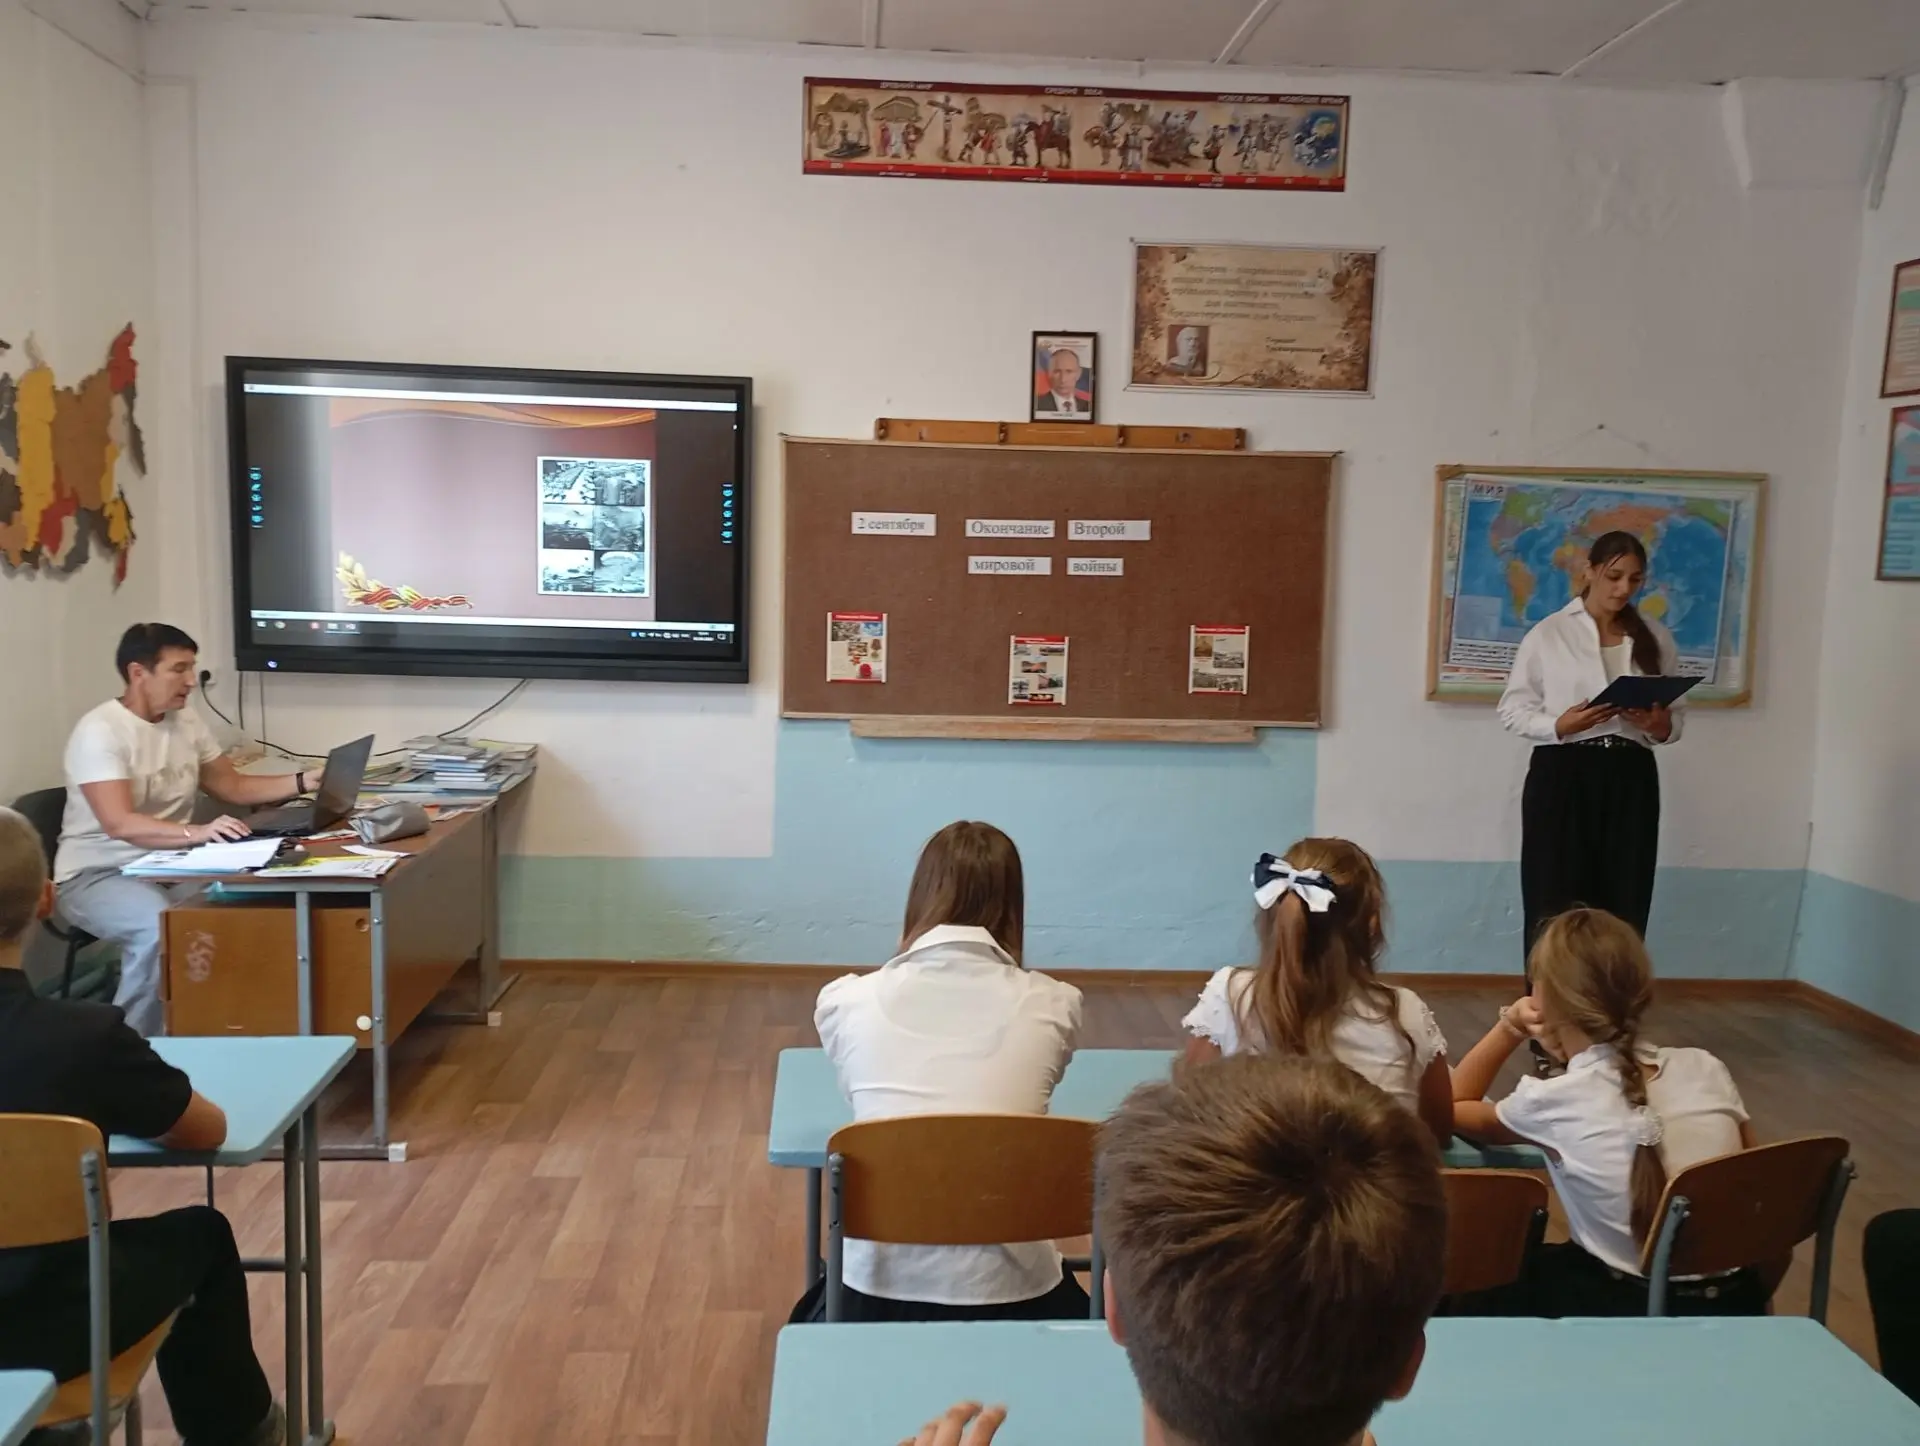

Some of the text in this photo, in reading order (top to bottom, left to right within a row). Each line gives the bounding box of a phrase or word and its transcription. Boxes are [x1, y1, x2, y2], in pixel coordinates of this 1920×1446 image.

[857, 517, 925, 533] 2 сентября
[971, 521, 1126, 538] Окончание Второй
[974, 559, 1117, 573] мировой войны
